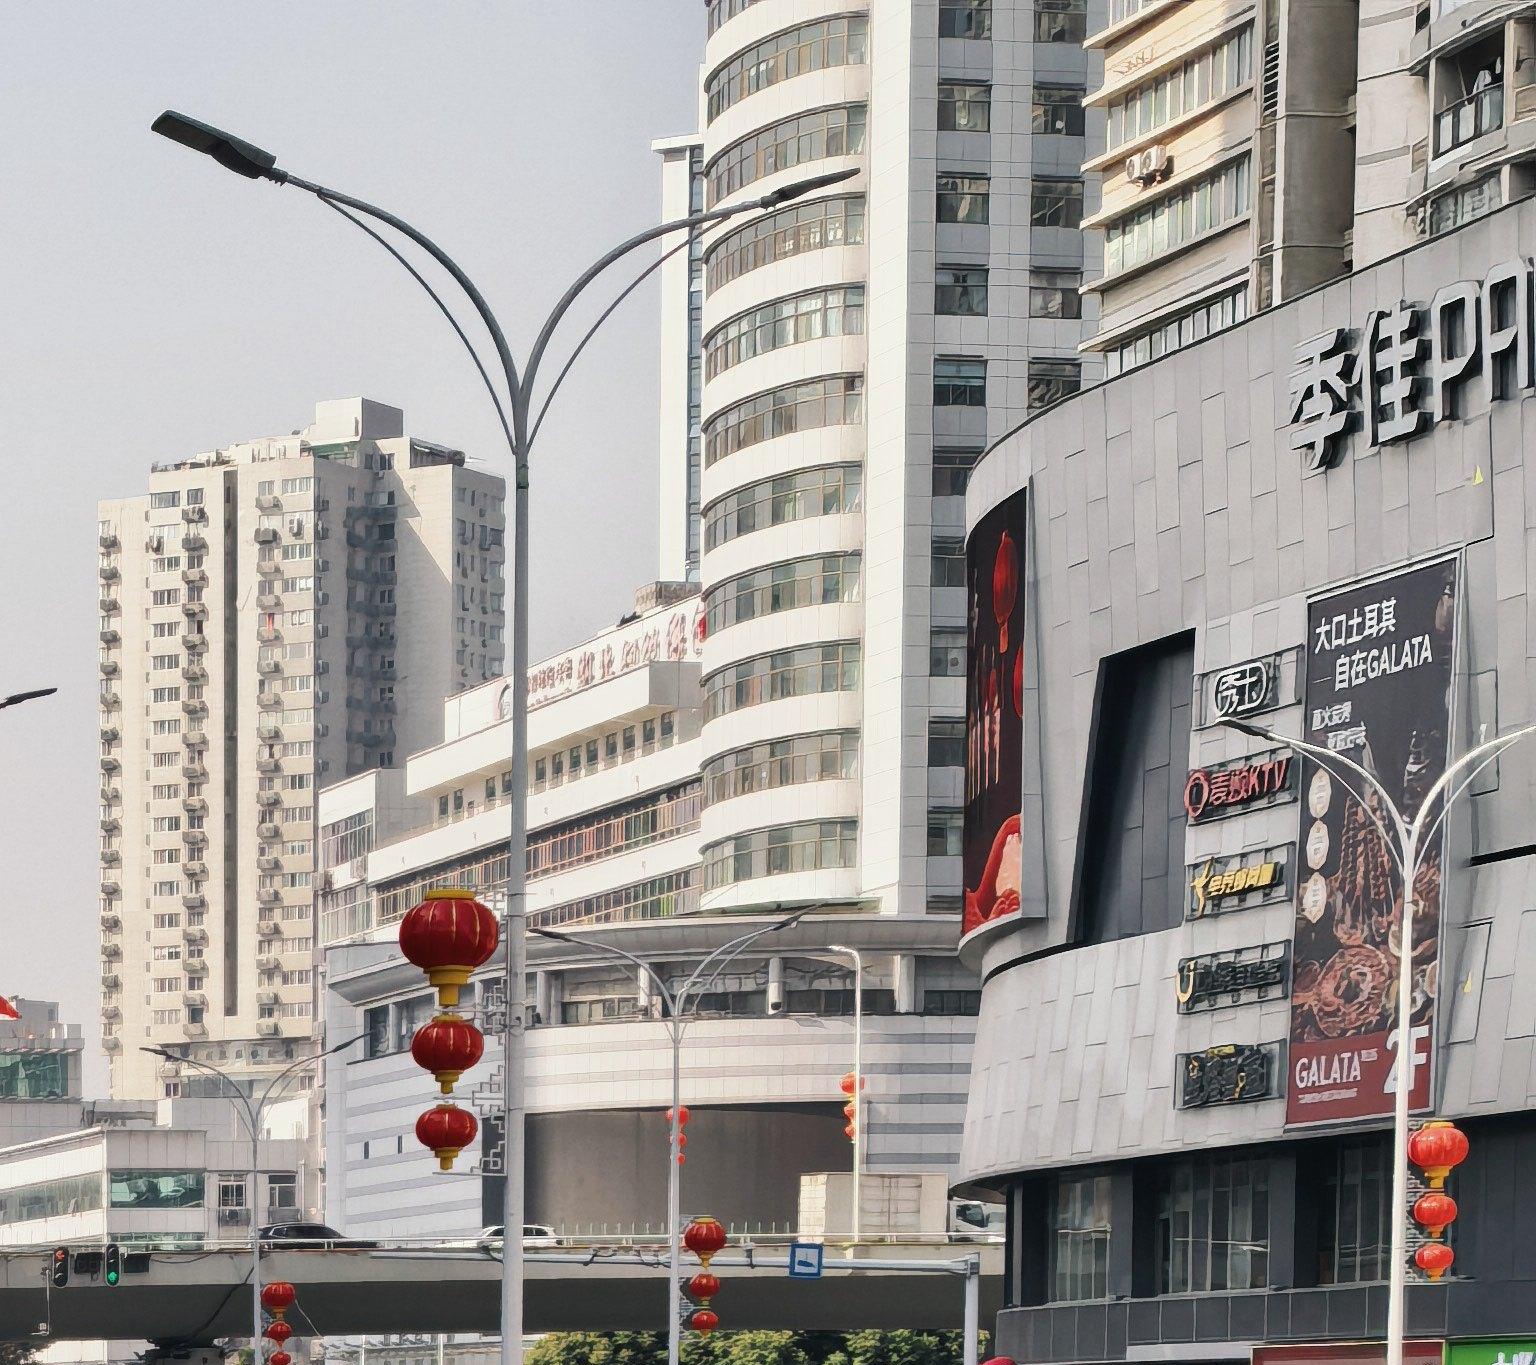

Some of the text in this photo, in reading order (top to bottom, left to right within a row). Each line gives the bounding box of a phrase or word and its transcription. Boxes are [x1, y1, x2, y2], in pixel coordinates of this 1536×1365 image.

[1286, 258, 1536, 471] 季佳PA
[1315, 597, 1397, 654] 大口土耳其
[1295, 1050, 1362, 1089] GALATA
